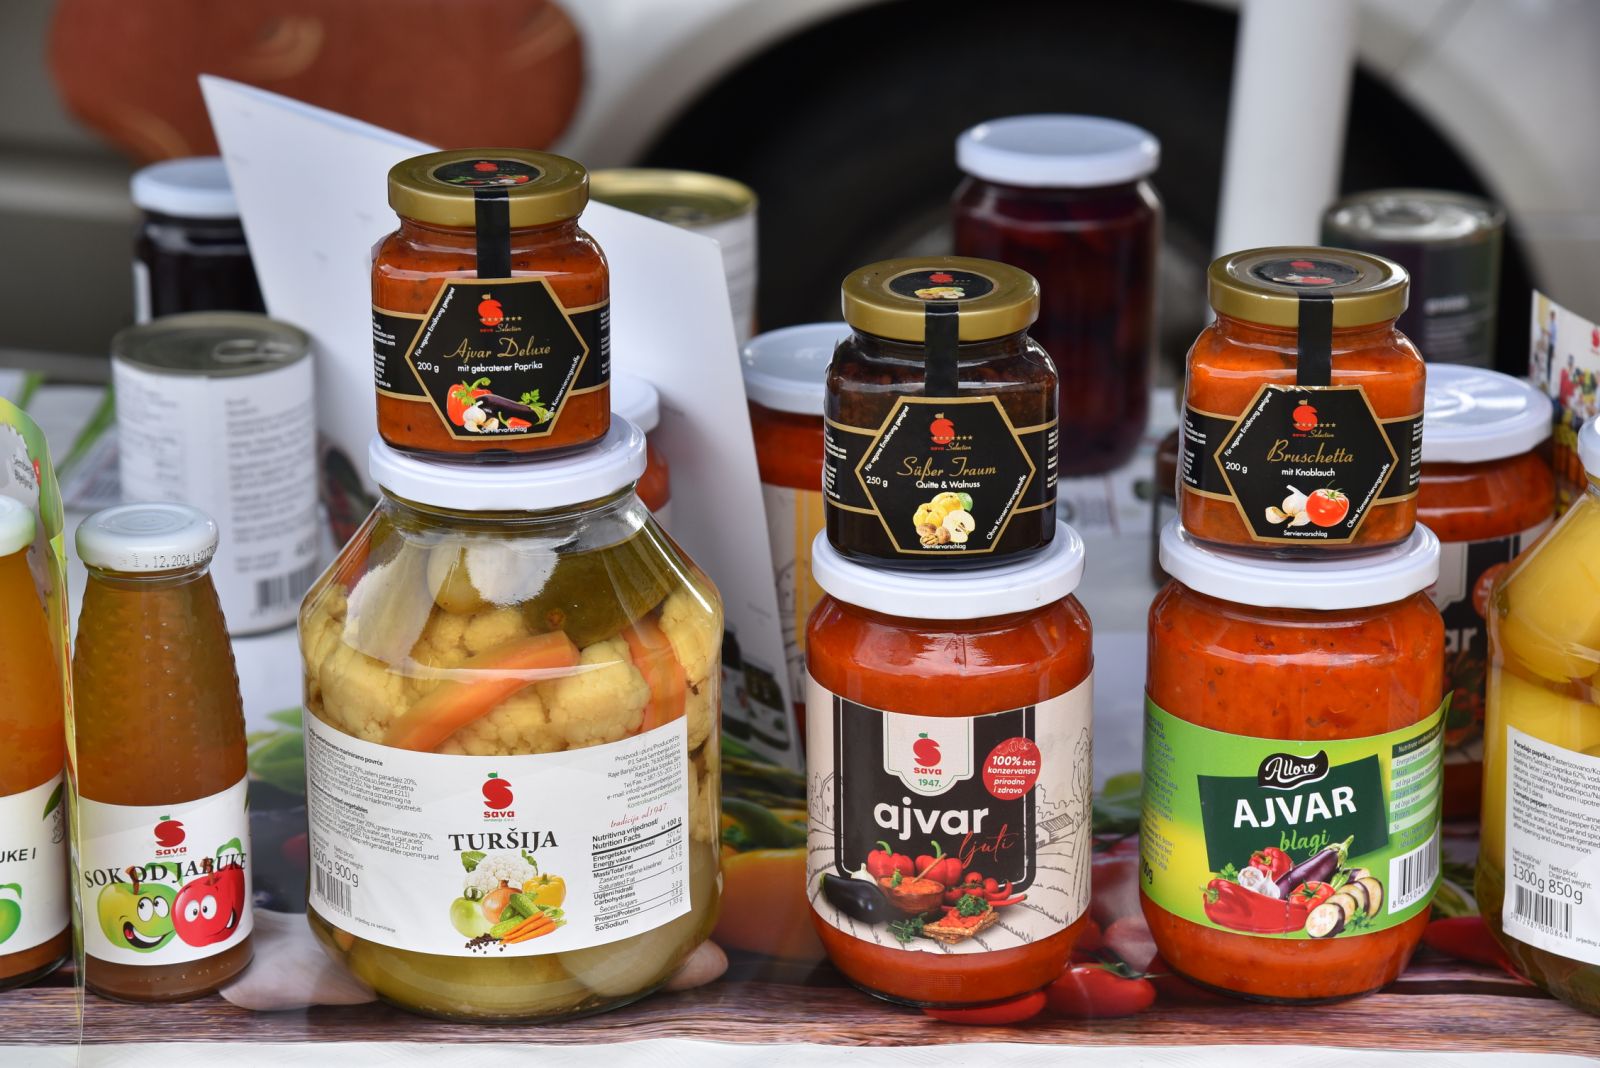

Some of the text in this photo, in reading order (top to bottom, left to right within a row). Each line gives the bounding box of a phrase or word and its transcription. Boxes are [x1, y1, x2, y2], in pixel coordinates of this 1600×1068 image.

[496, 324, 522, 332] Selection
[444, 335, 551, 364] Ajvar Deluxe
[417, 362, 440, 374] 200 g
[458, 361, 543, 374] mit gebratener Paprika
[1308, 430, 1334, 438] Selection
[946, 442, 972, 450] Selection
[1267, 439, 1354, 463] Bruschetta
[896, 456, 996, 482] Süßer Traum
[1226, 462, 1248, 474] 200 g
[1282, 468, 1336, 476] mit Knoblauch
[866, 476, 888, 488] 250 g
[916, 480, 980, 489] Quitte & Walnuss
[1284, 530, 1328, 538] Serviervorschlag
[992, 756, 1036, 766] 100% bez
[914, 767, 942, 776] sava
[988, 766, 1036, 775] konzervansa
[1264, 756, 1318, 782] Alloro
[918, 778, 942, 788] 1947.
[994, 778, 1026, 786] prirodno
[998, 786, 1022, 794] zdravo
[1234, 786, 1357, 829] AJVAR
[484, 810, 514, 818] sava
[874, 796, 988, 841] ajvar
[1560, 823, 1574, 834] sugar
[1575, 828, 1586, 837] and
[1568, 818, 1590, 831] pepper
[448, 827, 559, 854] TURŠIJA
[592, 828, 626, 842] Nutritivna
[592, 832, 642, 850] Nutrition Facts
[410, 844, 422, 852] and
[958, 824, 1020, 870] ljuti
[1280, 829, 1330, 857] blagi
[1551, 838, 1576, 850] consume
[155, 846, 188, 856] sava
[402, 850, 427, 861] opening
[427, 853, 440, 861] and
[593, 855, 632, 870] Energy value
[84, 852, 248, 889] SOK OD JABUKE
[1548, 864, 1562, 874] Neto
[594, 892, 636, 906] Carbohydrates
